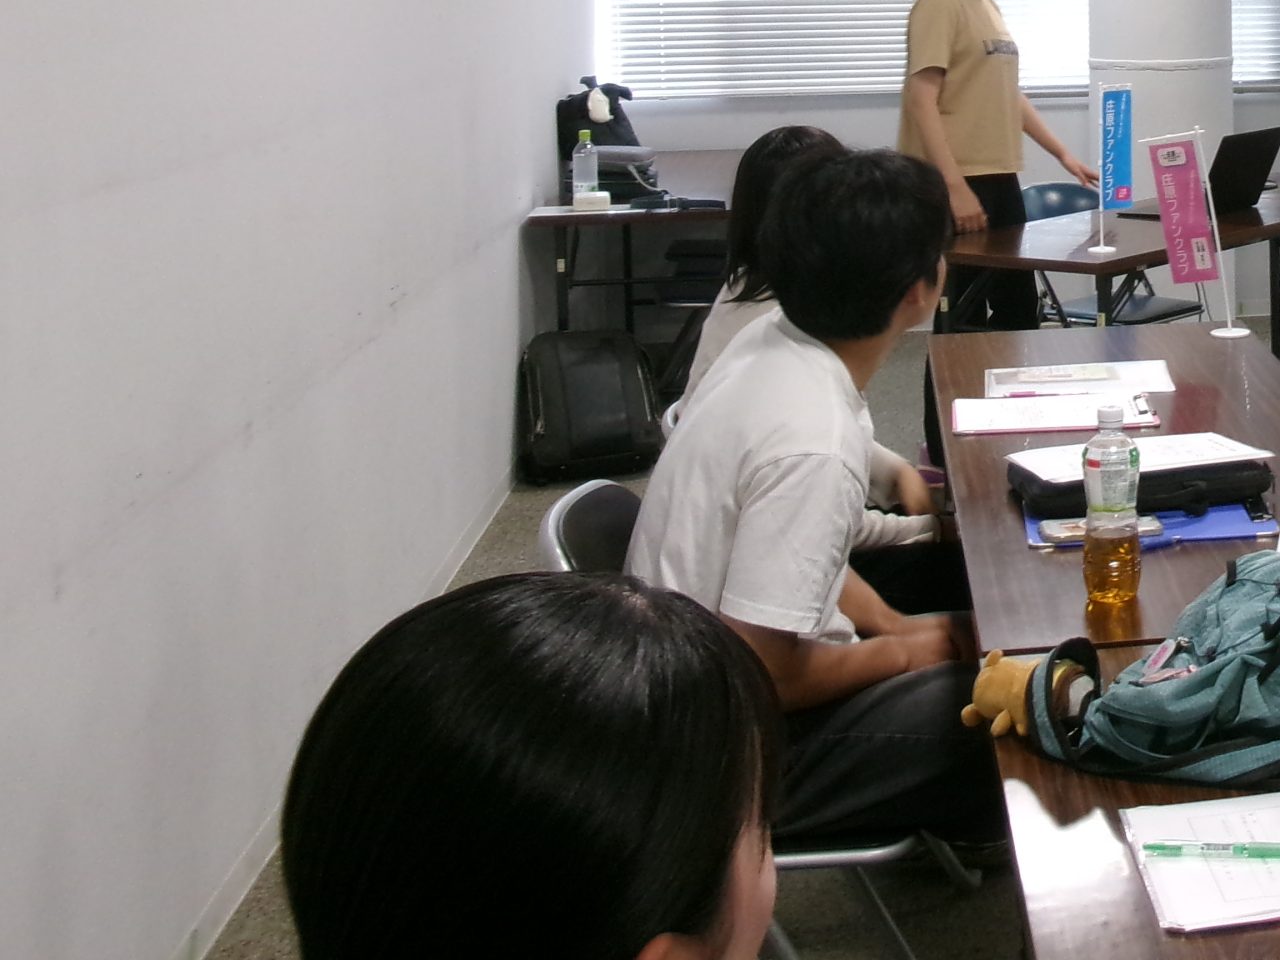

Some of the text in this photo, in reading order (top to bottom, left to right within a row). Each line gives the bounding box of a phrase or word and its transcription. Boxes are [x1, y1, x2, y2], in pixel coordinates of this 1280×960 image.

[1104, 99, 1117, 202] 庄原ファンクラブ
[1161, 172, 1189, 276] 庄原ファンクラブ
